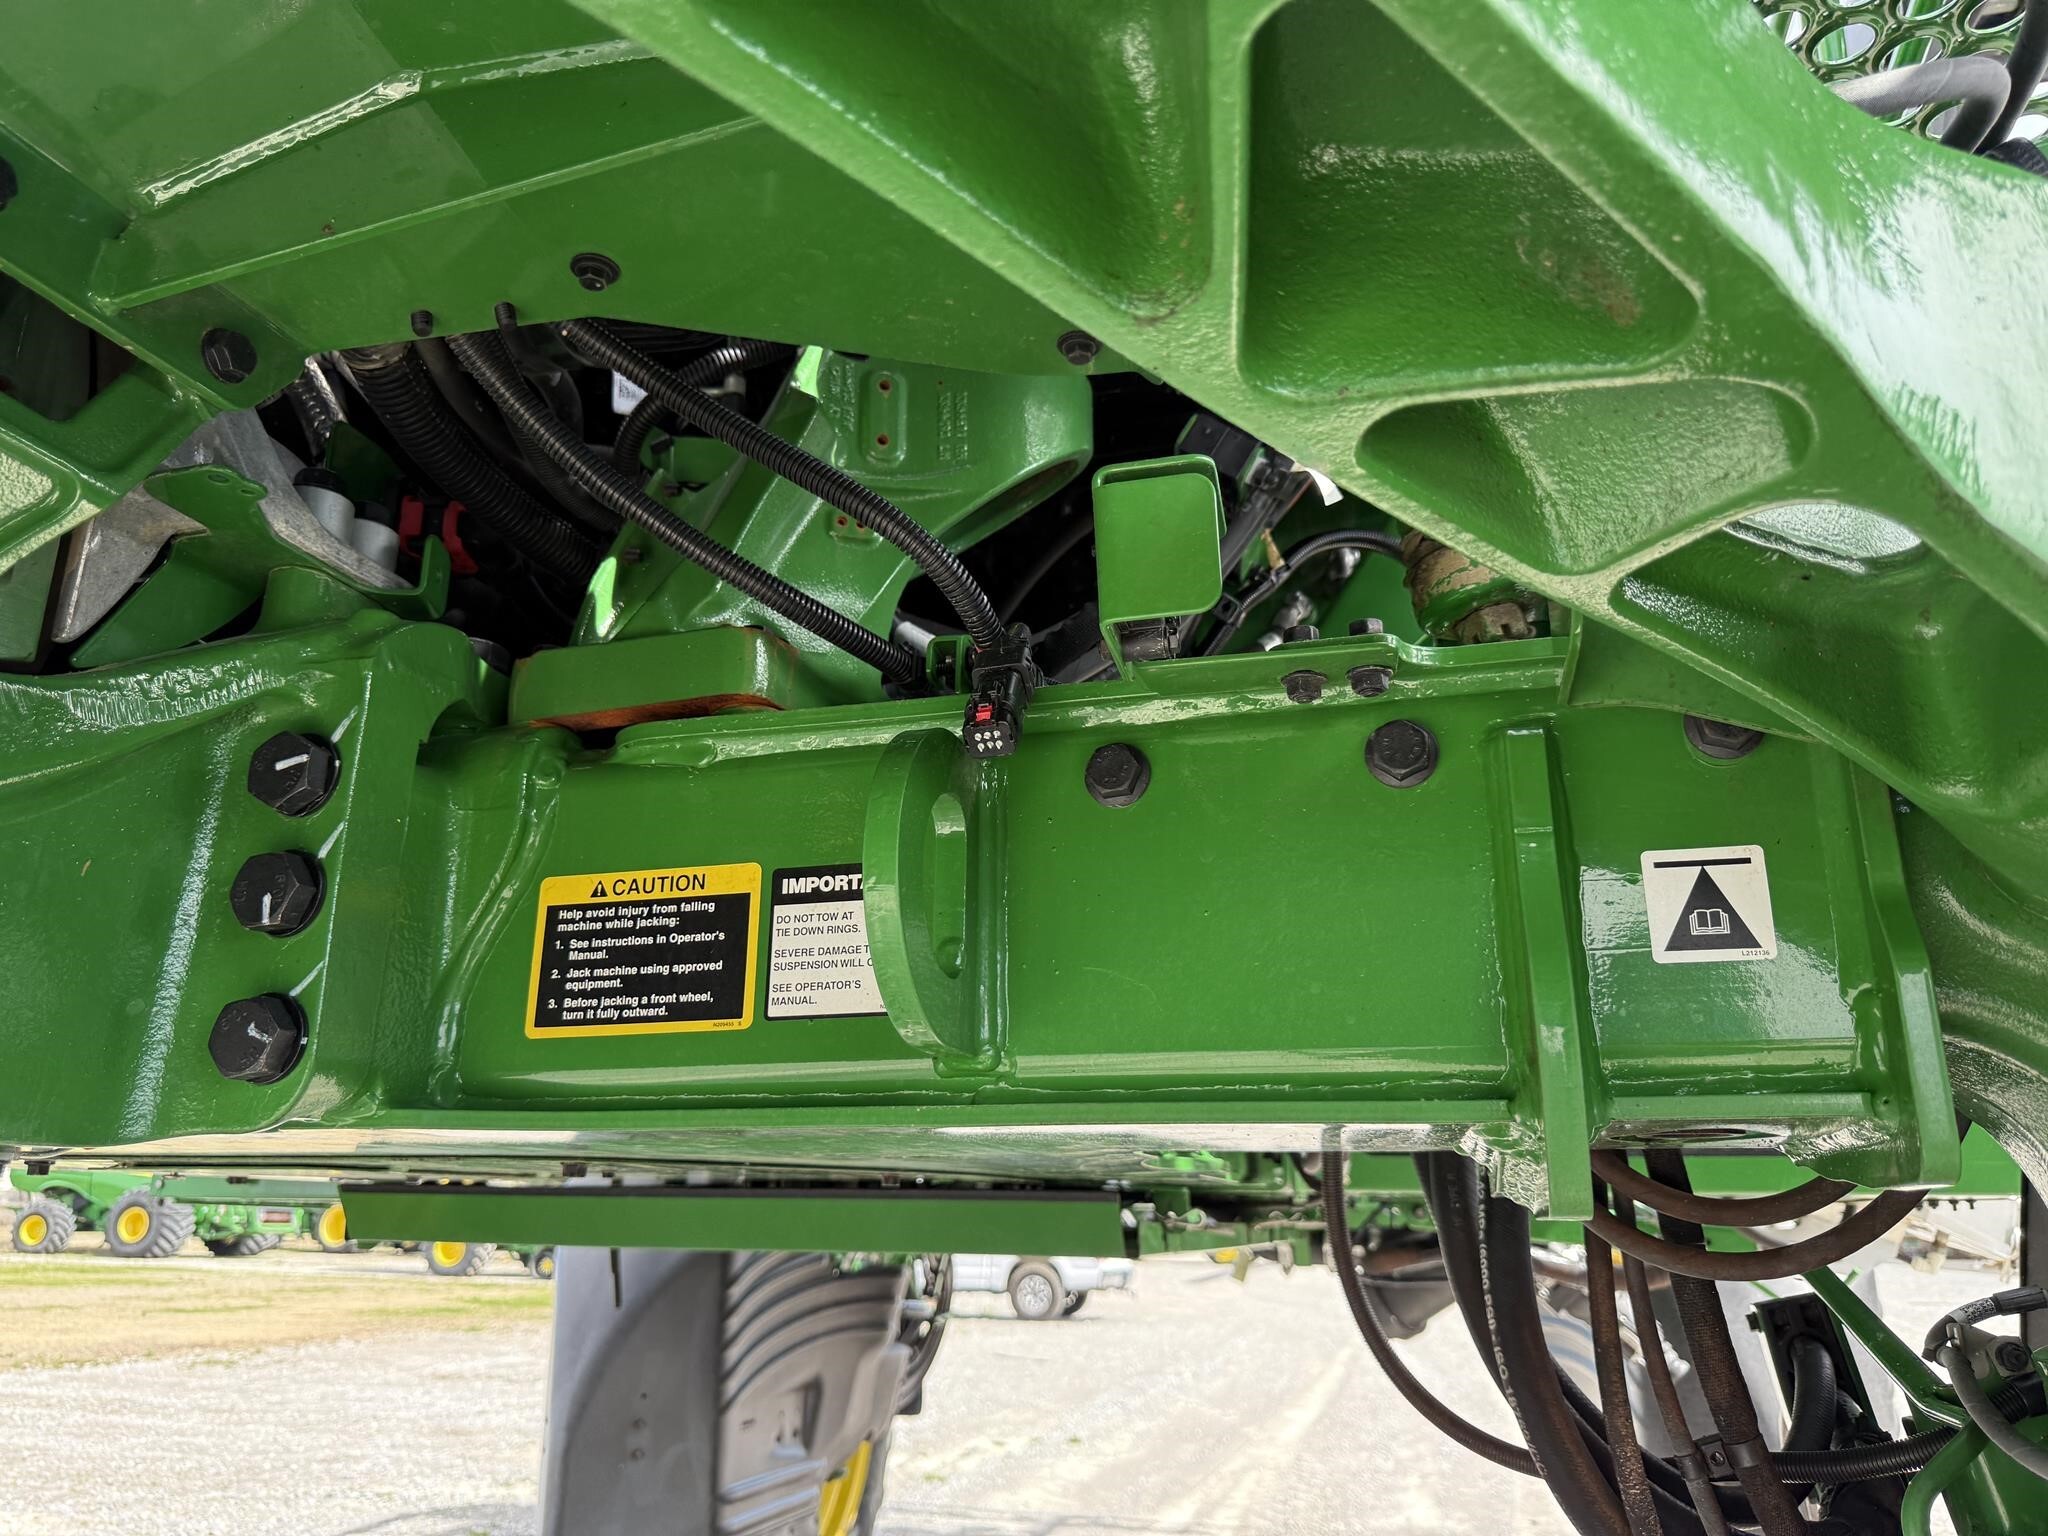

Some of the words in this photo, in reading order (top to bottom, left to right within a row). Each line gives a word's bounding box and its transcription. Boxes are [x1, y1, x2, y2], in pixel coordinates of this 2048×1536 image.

[612, 873, 706, 896] CAUTION
[559, 910, 584, 920] Help
[585, 907, 615, 918] avoid
[618, 905, 649, 917] injury
[652, 904, 677, 914] from
[680, 901, 716, 912] falling
[776, 915, 791, 924] DO
[793, 914, 815, 923] NOT
[816, 912, 839, 922] TOW
[841, 911, 854, 920] AT
[557, 920, 602, 932] machine
[605, 918, 634, 929] while
[636, 916, 680, 929] jacking:
[776, 928, 790, 937] TIE
[793, 926, 824, 936] DOWN
[826, 924, 861, 934] RINGS.
[555, 940, 564, 949] 1.
[569, 938, 589, 949] See
[591, 935, 654, 947] instructions
[656, 934, 666, 944] in
[669, 930, 726, 945] Operator's
[568, 949, 609, 960] Manual.
[774, 948, 815, 958] SEVERE
[818, 945, 862, 956] DAMAGE
[863, 945, 870, 953] T
[551, 969, 561, 979] 2.
[566, 967, 591, 978] Jack
[593, 965, 638, 976] machine
[640, 963, 670, 975] using
[672, 960, 723, 974] approved
[773, 960, 838, 971] SUSPENSION
[840, 959, 864, 968] WILL
[565, 978, 623, 992] equipment.
[772, 983, 792, 992] SEE
[795, 980, 861, 991] OPERATOR'S
[547, 998, 558, 1009] 3.
[563, 997, 598, 1008] Before
[600, 995, 639, 1008] jacking
[641, 996, 648, 1004] a
[650, 993, 677, 1003] front
[679, 991, 714, 1002] wheel,
[771, 996, 818, 1006] MANUAL.
[563, 1010, 584, 1020] turn
[586, 1009, 595, 1019] it
[596, 1008, 620, 1020] fully
[622, 1005, 668, 1017] outward.
[1479, 1243, 1490, 1289] (6000
[1493, 1346, 1508, 1379] ISO
